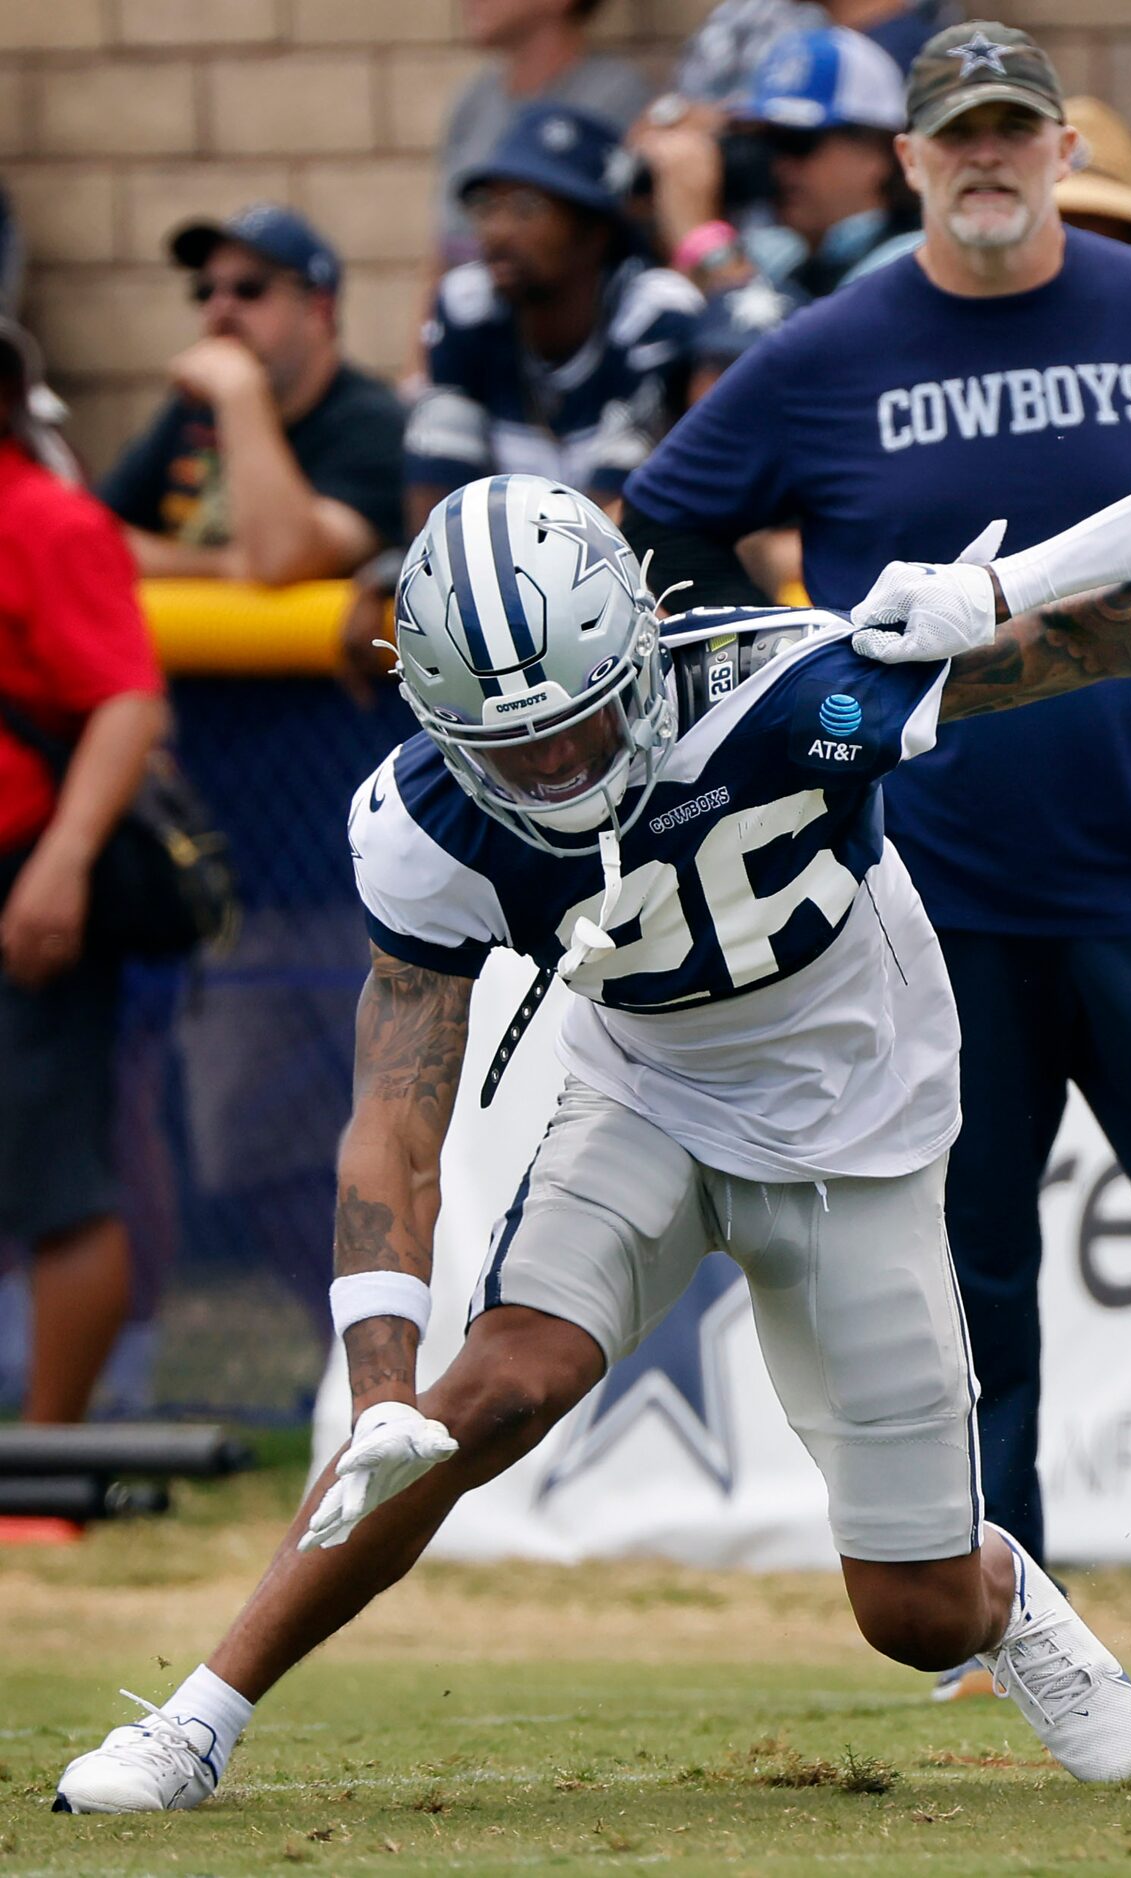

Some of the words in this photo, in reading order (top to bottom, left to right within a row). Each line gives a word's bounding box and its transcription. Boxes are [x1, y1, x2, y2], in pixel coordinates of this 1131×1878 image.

[711, 666, 731, 696] 26
[496, 692, 547, 713] COWBOYS
[808, 739, 862, 762] AT&T
[649, 786, 730, 834] COWBOYS
